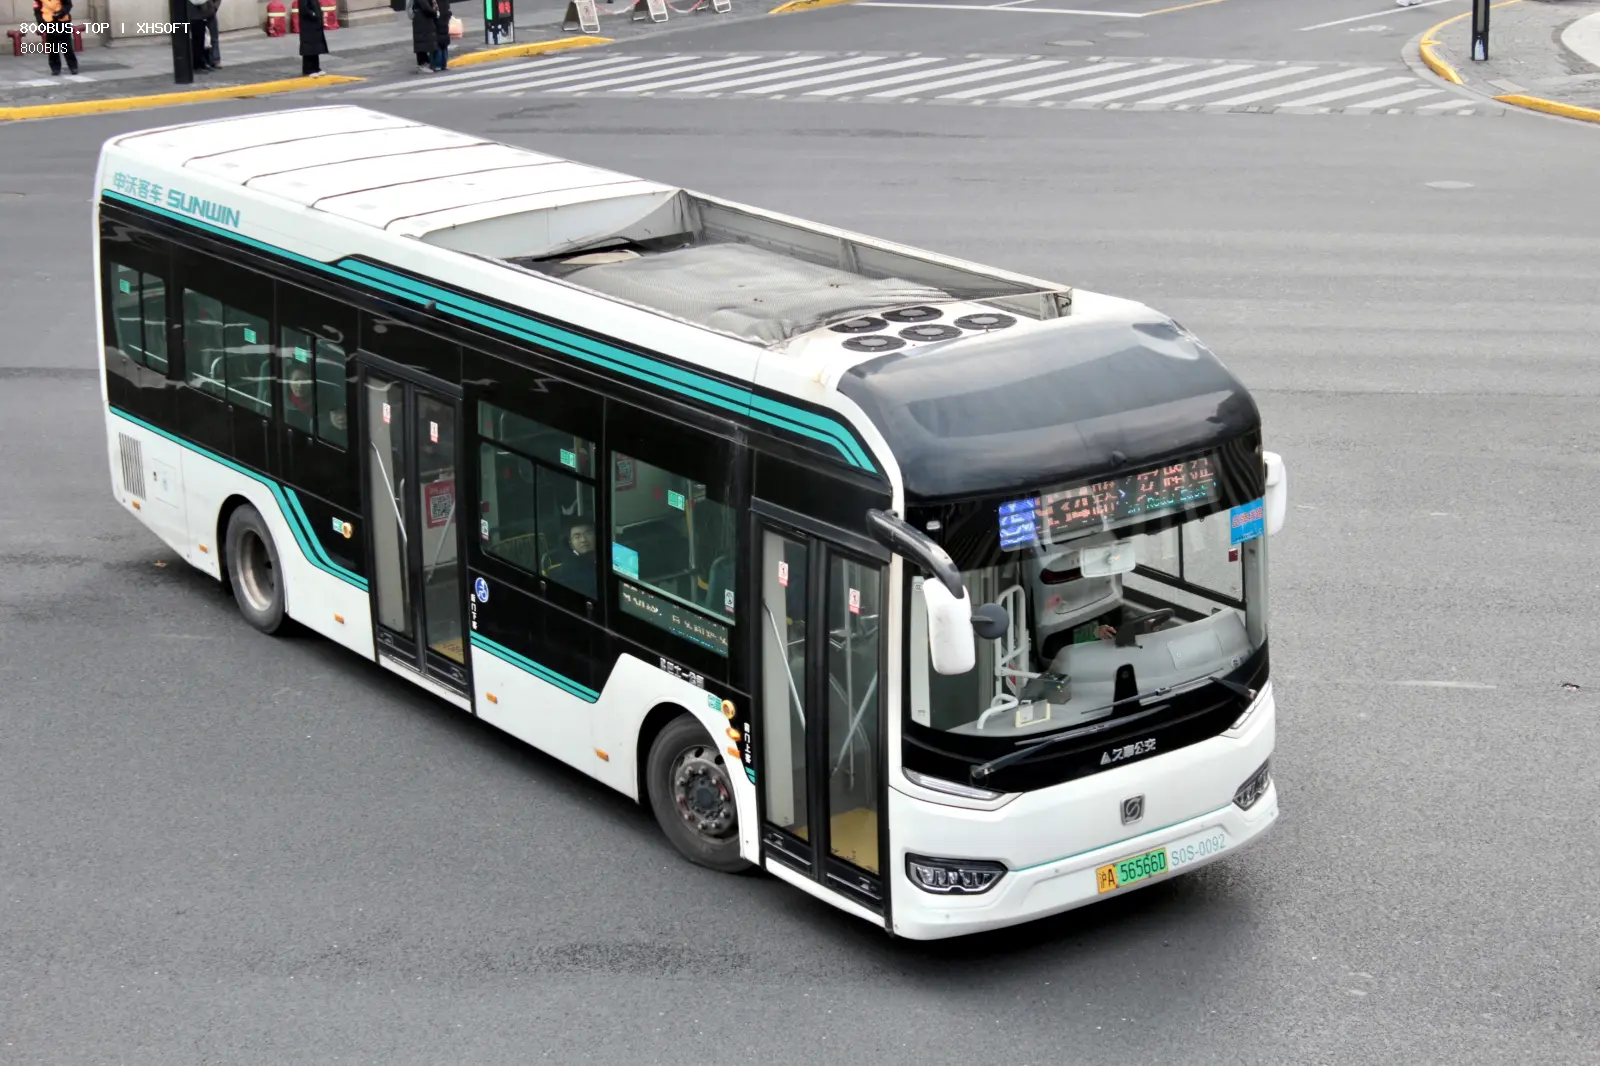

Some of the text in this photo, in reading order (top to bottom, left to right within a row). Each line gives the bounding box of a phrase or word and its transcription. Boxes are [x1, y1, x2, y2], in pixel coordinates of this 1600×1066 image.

[114, 172, 163, 203] 申沃客车
[168, 189, 240, 228] SUNWIN
